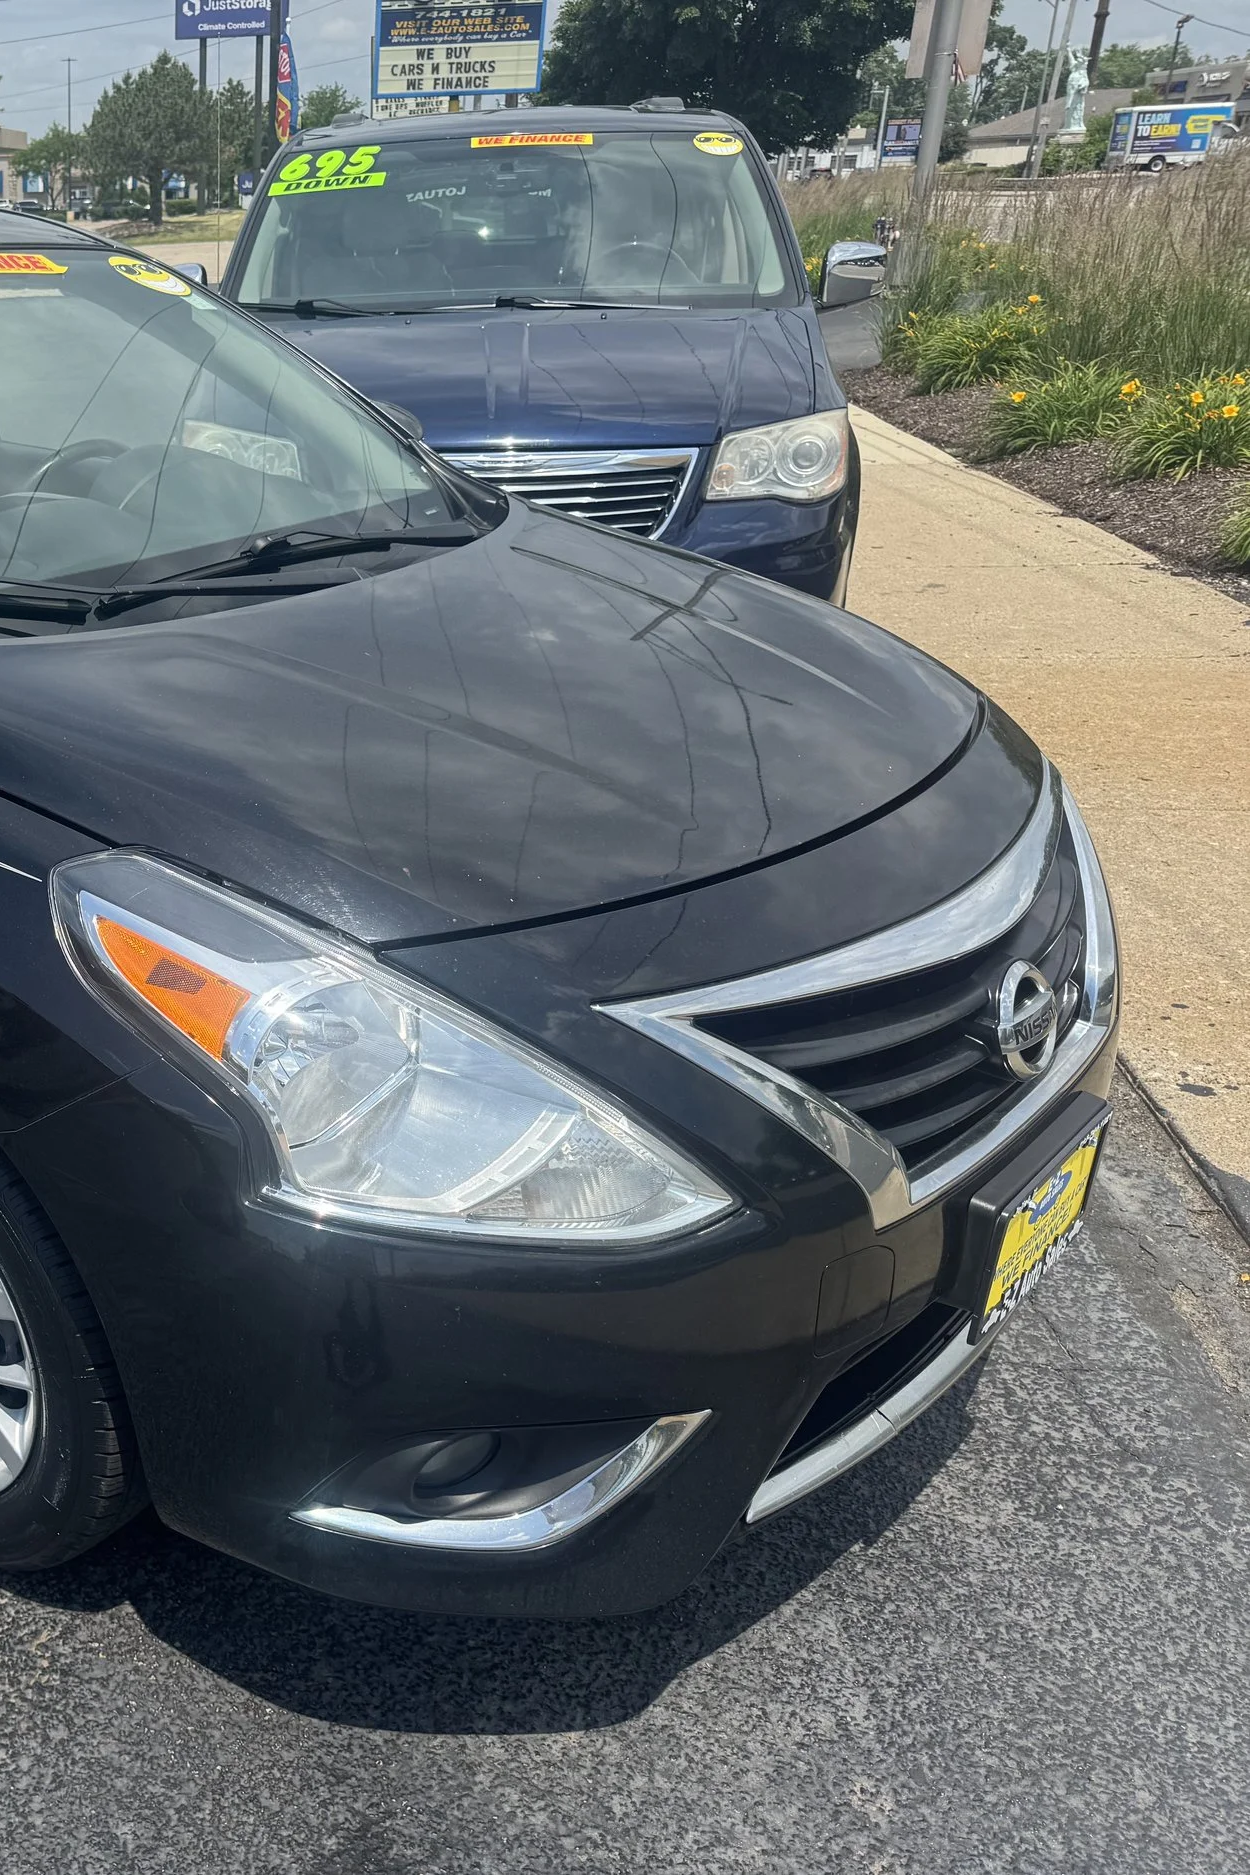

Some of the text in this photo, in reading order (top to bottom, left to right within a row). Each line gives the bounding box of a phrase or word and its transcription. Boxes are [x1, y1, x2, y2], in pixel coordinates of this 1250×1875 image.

[203, 0, 272, 11] JustStorag
[415, 8, 507, 18] 744-1821
[198, 21, 266, 31] Climate Controlled
[395, 16, 525, 29] VISIT OUR WEB SITE
[390, 23, 531, 36] WWW.E-ZAUTOSALES.COM
[422, 33, 464, 43] everybody
[483, 32, 498, 41] buy
[416, 47, 472, 60] WE BUY
[391, 63, 425, 76] CARS
[448, 60, 496, 74] TRUCKS
[406, 76, 490, 91] WE FINANCE
[1138, 113, 1171, 125] LEARN
[1137, 125, 1150, 136] TO
[478, 135, 584, 145] WE FINANCE
[279, 145, 381, 182] 695
[284, 175, 370, 192] DOWN
[1001, 1260, 1020, 1288] WE
